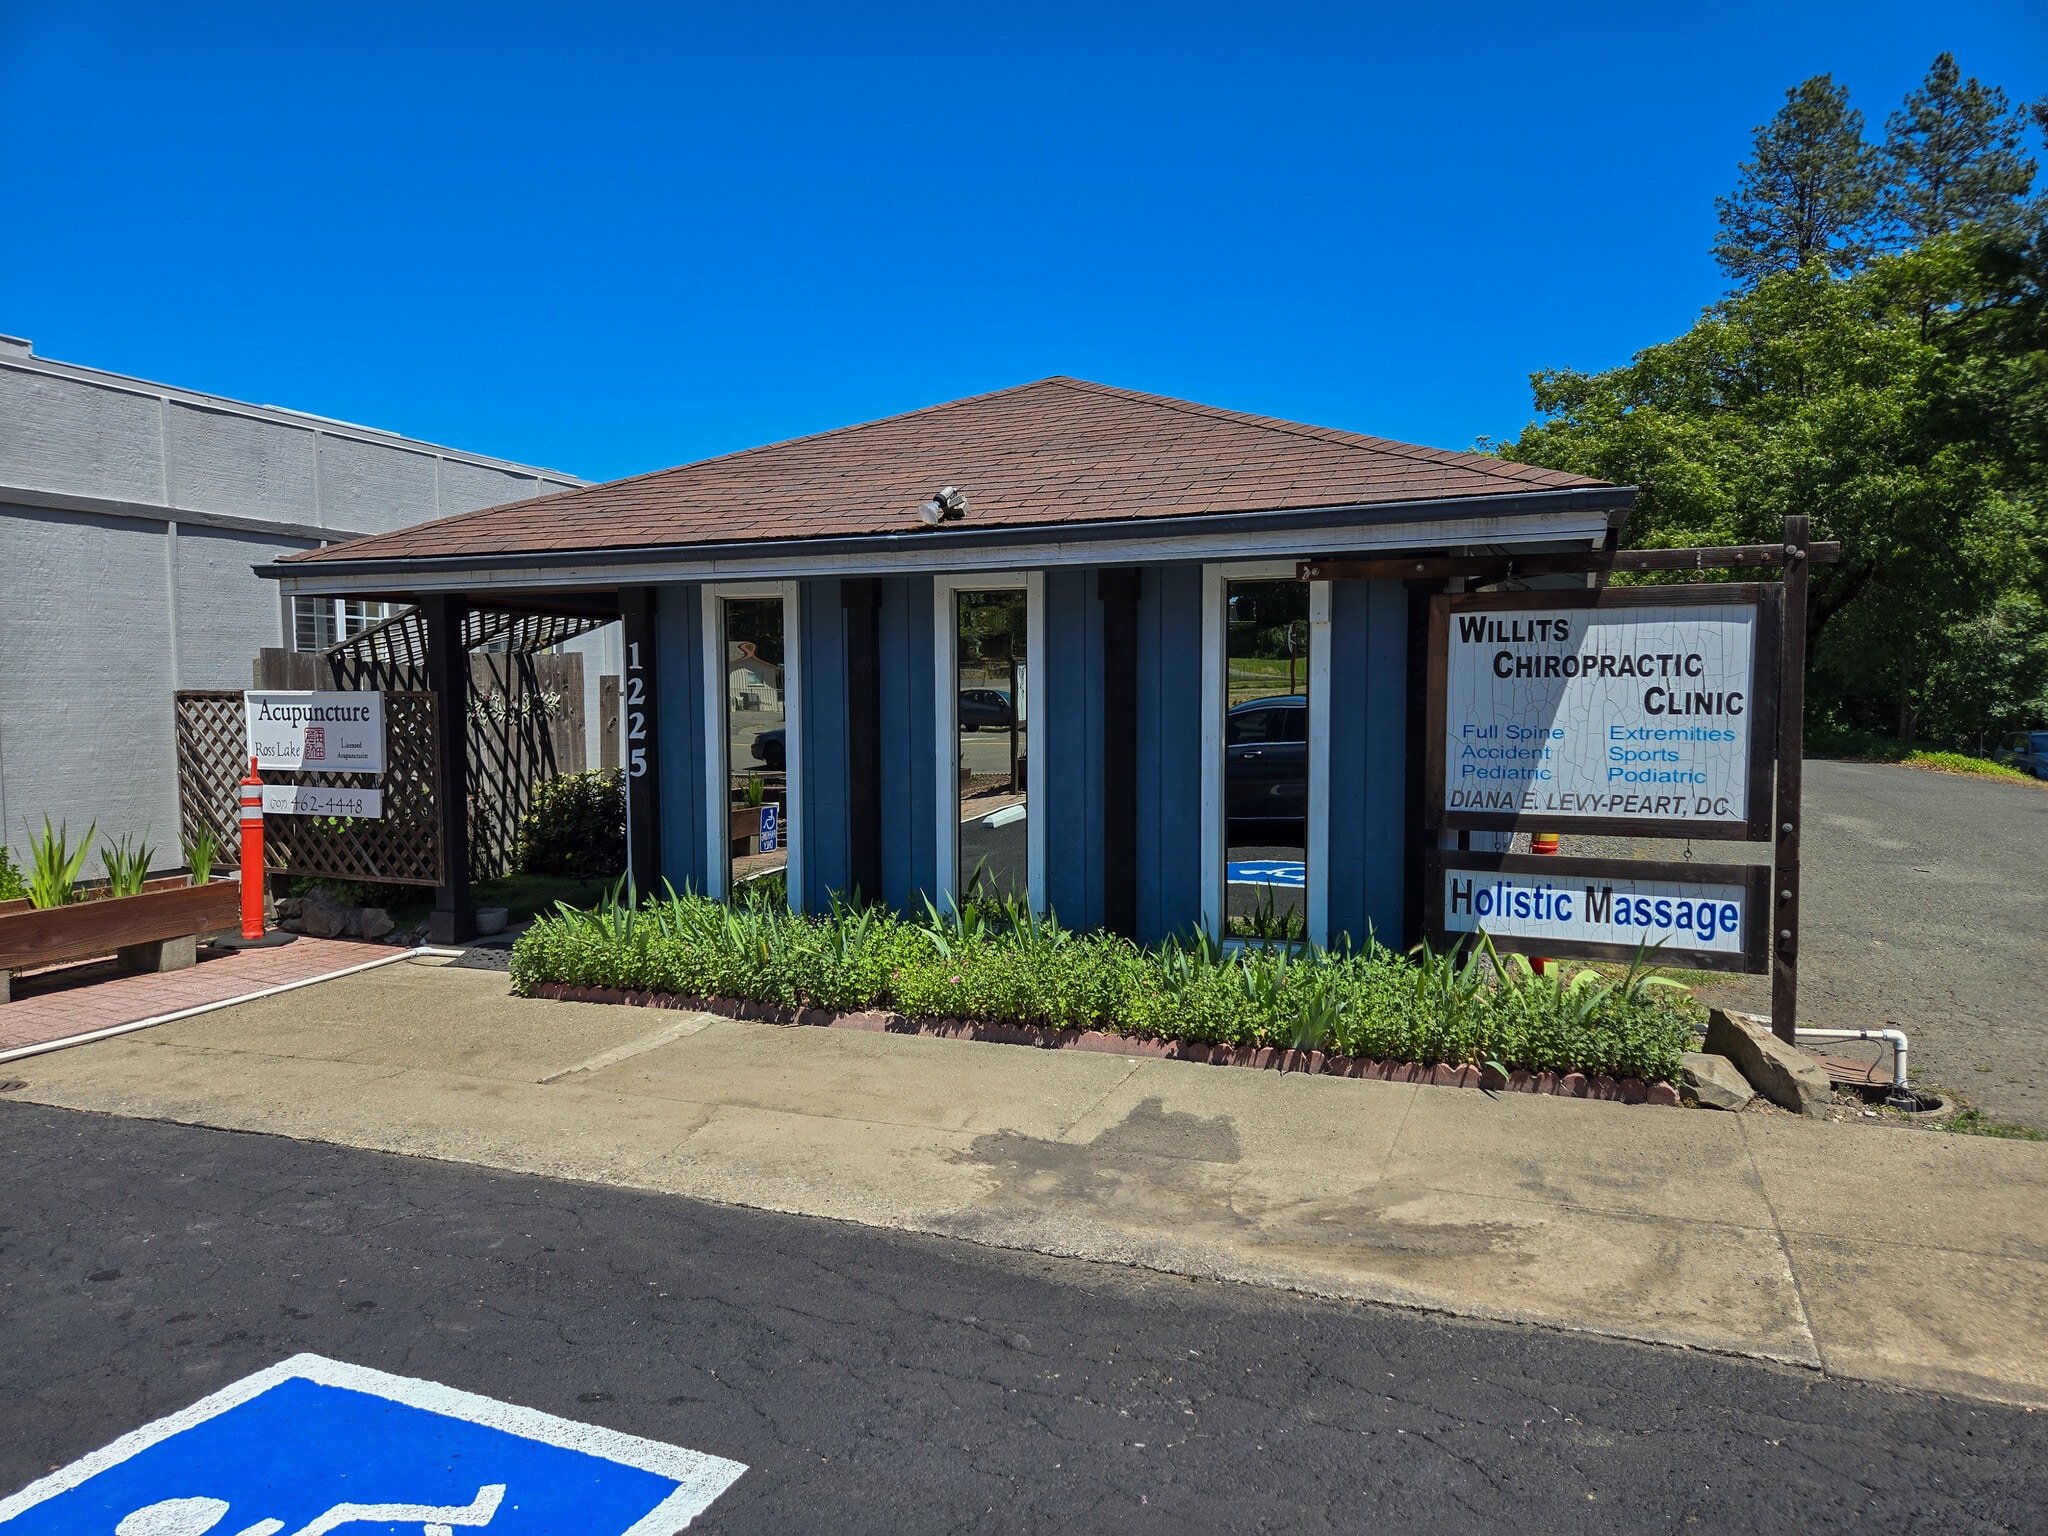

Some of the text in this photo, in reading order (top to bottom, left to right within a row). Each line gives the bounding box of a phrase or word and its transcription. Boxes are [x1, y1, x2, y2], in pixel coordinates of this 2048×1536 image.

[1458, 615, 1570, 643] WILLITS
[1492, 650, 1703, 679] CHIROPRACTIC
[627, 641, 647, 778] 1225
[1643, 685, 1745, 716] CLINIC
[258, 699, 370, 728] Acupuncture
[1462, 724, 1565, 744] Full Spine
[1609, 725, 1736, 743] Extremities
[255, 741, 275, 756] Ross
[277, 741, 301, 758] Lake
[1461, 744, 1551, 761] Accident
[1608, 746, 1680, 765] Sports
[1461, 764, 1552, 781] Pediatric
[1607, 766, 1707, 785] Podiatric
[270, 793, 363, 814] (707) 462-4448
[1450, 789, 1731, 818] DIANA E. LEVY-PEART, DC
[1451, 877, 1740, 942] Holistic Massage
